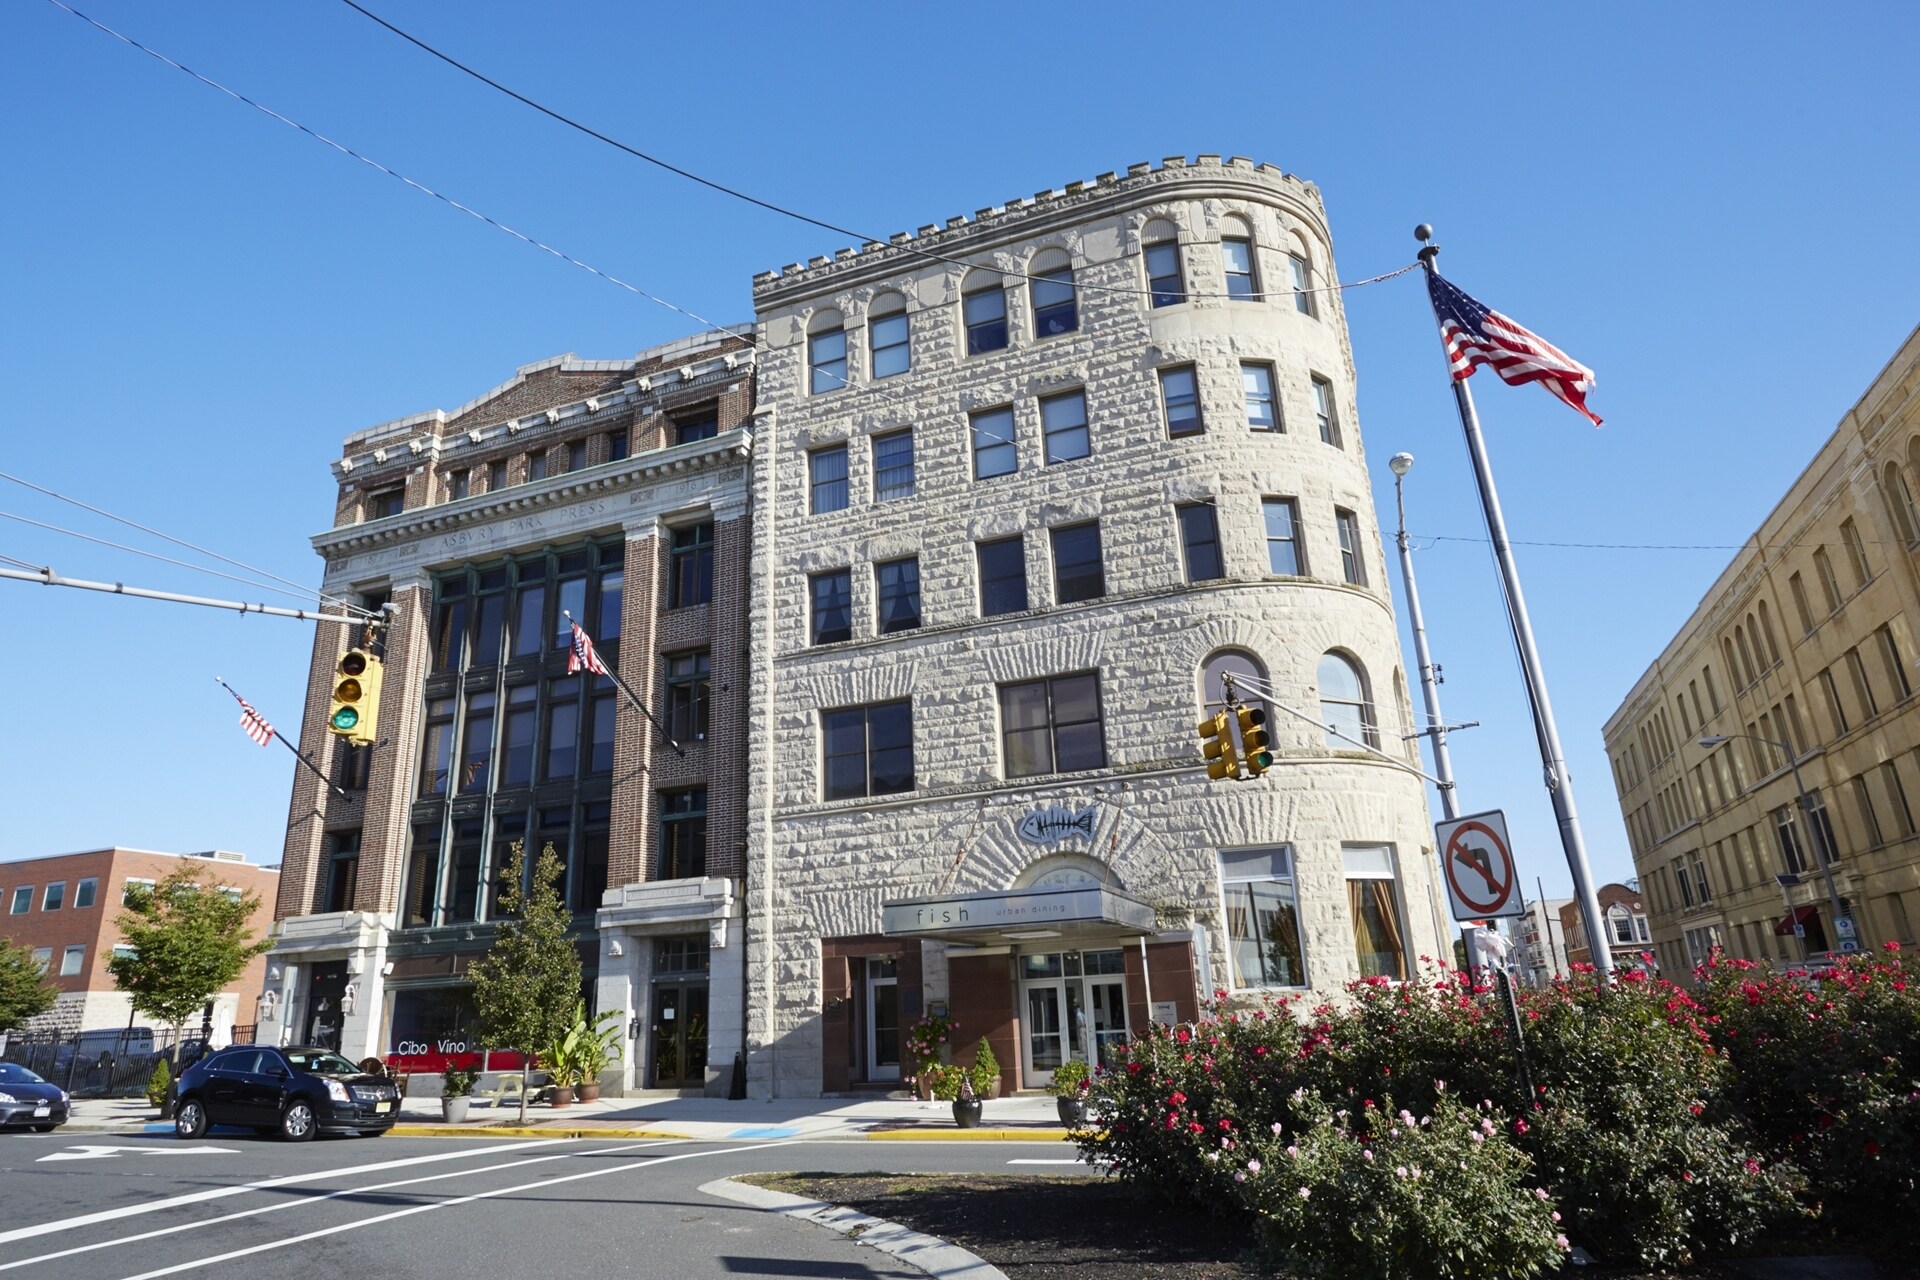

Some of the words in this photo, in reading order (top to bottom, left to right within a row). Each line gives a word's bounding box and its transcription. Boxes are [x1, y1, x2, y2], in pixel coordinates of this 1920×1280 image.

[509, 516, 544, 533] PARK
[560, 501, 605, 521] PRESS
[916, 906, 969, 924] fish
[996, 906, 1026, 916] urban
[1031, 904, 1065, 913] dining
[398, 1040, 428, 1055] Cibo
[437, 1039, 466, 1053] Vino
